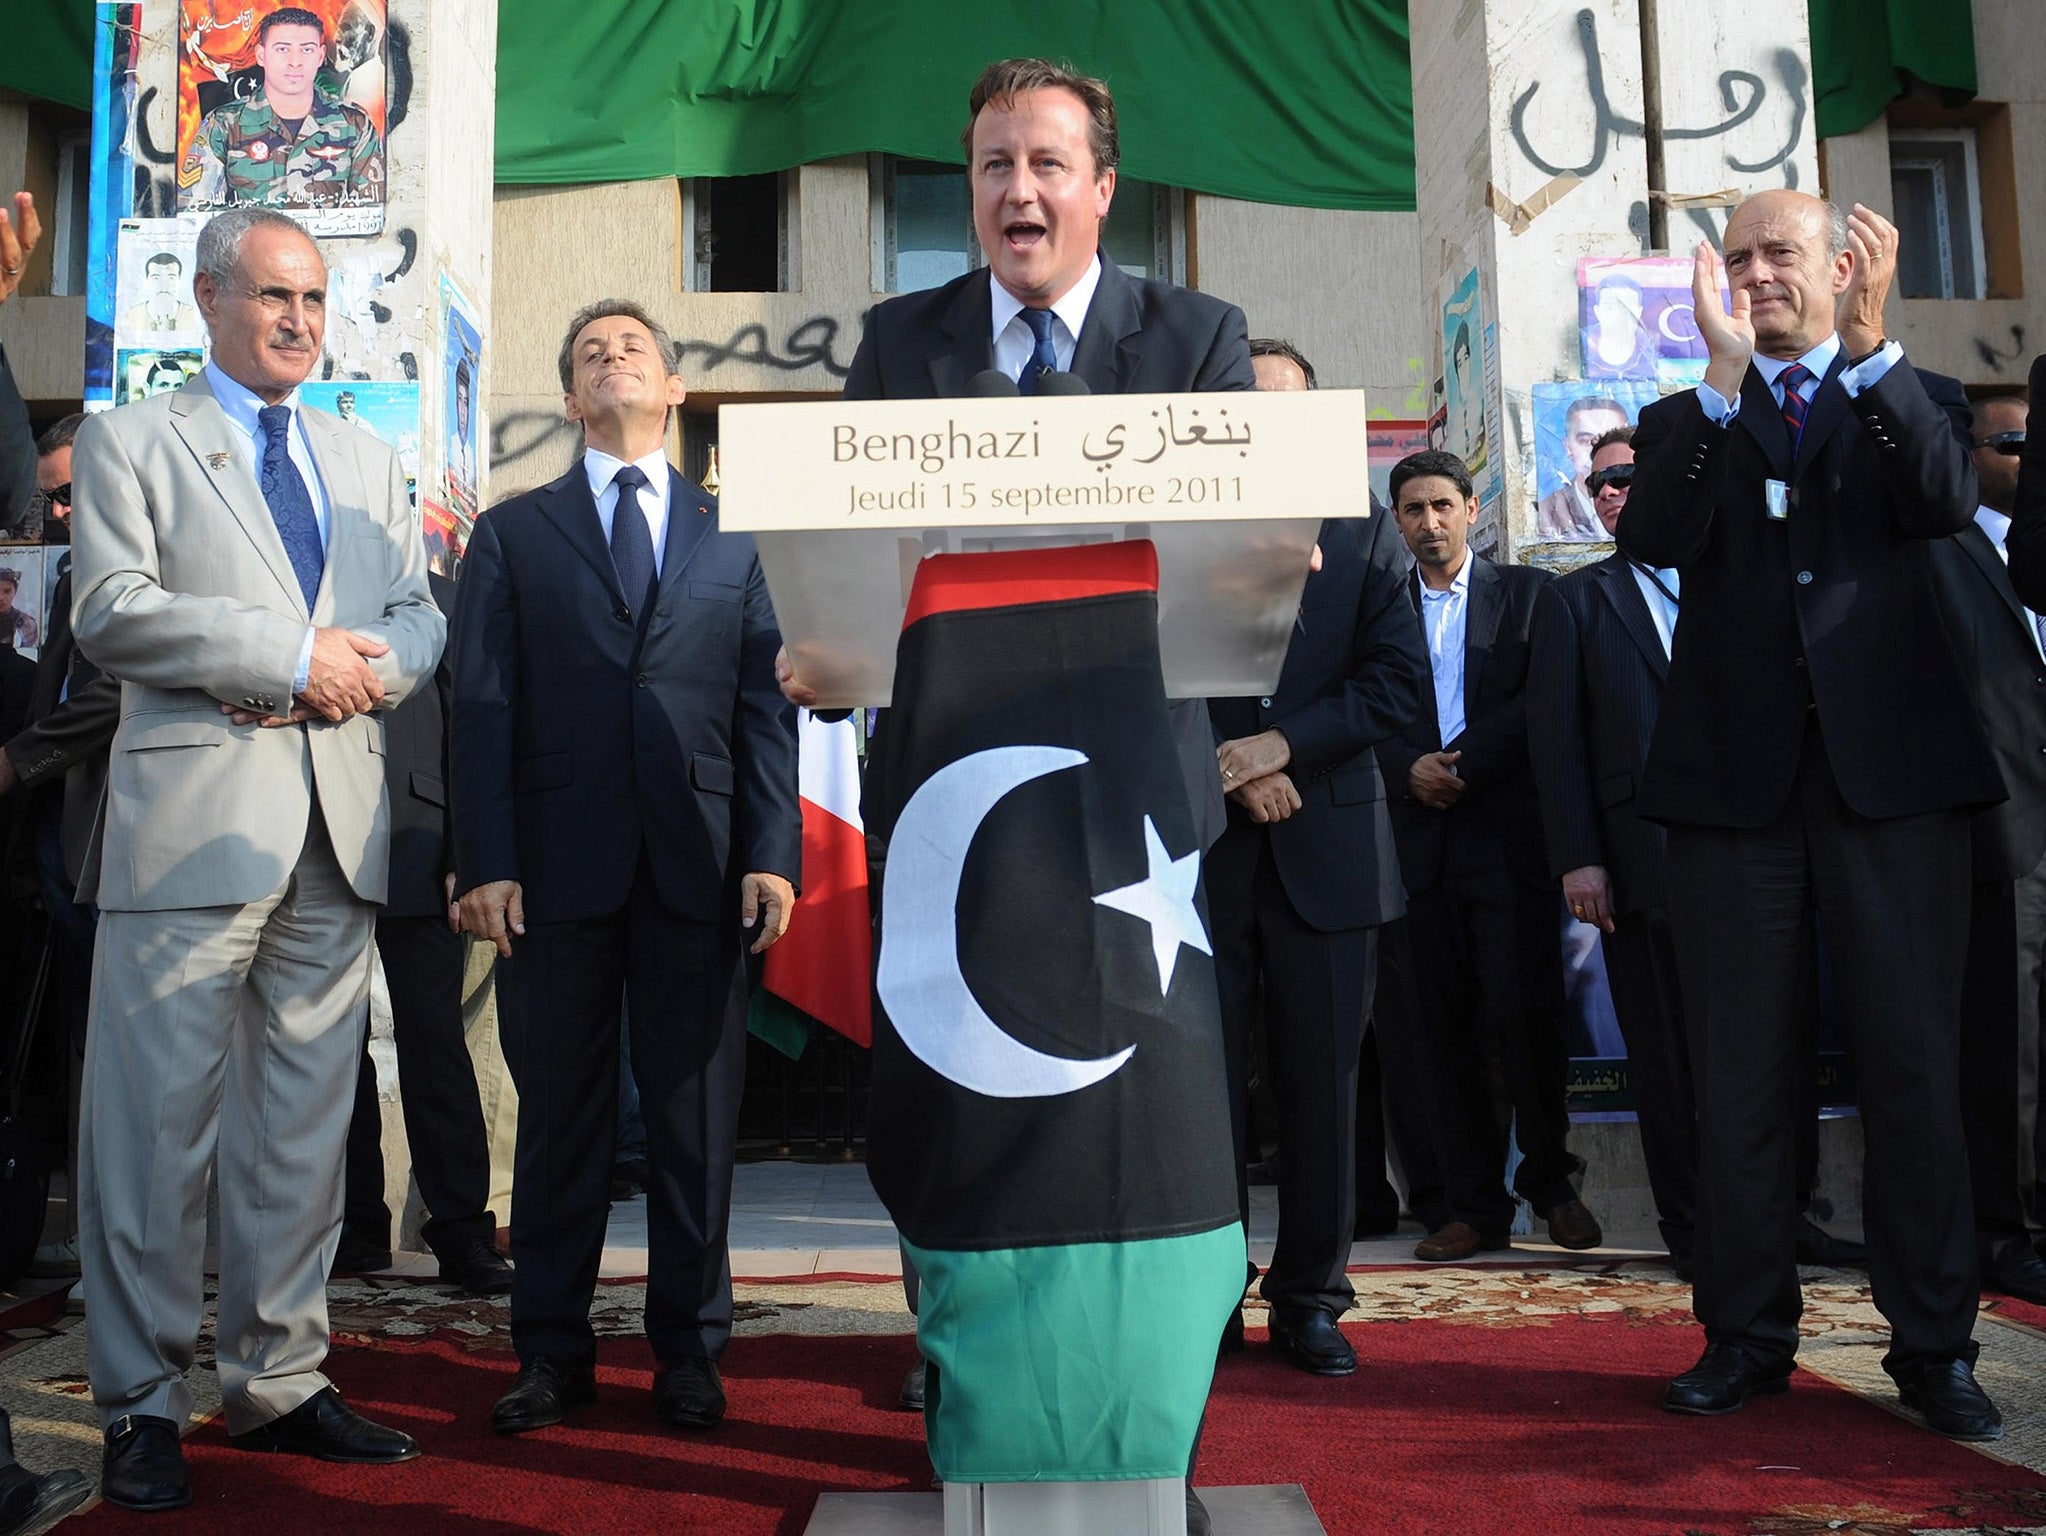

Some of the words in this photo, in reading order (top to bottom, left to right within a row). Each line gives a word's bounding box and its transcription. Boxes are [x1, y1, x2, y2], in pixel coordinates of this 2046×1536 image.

[832, 419, 1040, 474] Benghazi
[1081, 403, 1252, 473] بنغازي
[847, 481, 926, 516] Jeudi
[940, 482, 977, 510] 15
[990, 477, 1155, 516] septembre
[1166, 476, 1242, 504] 2011
